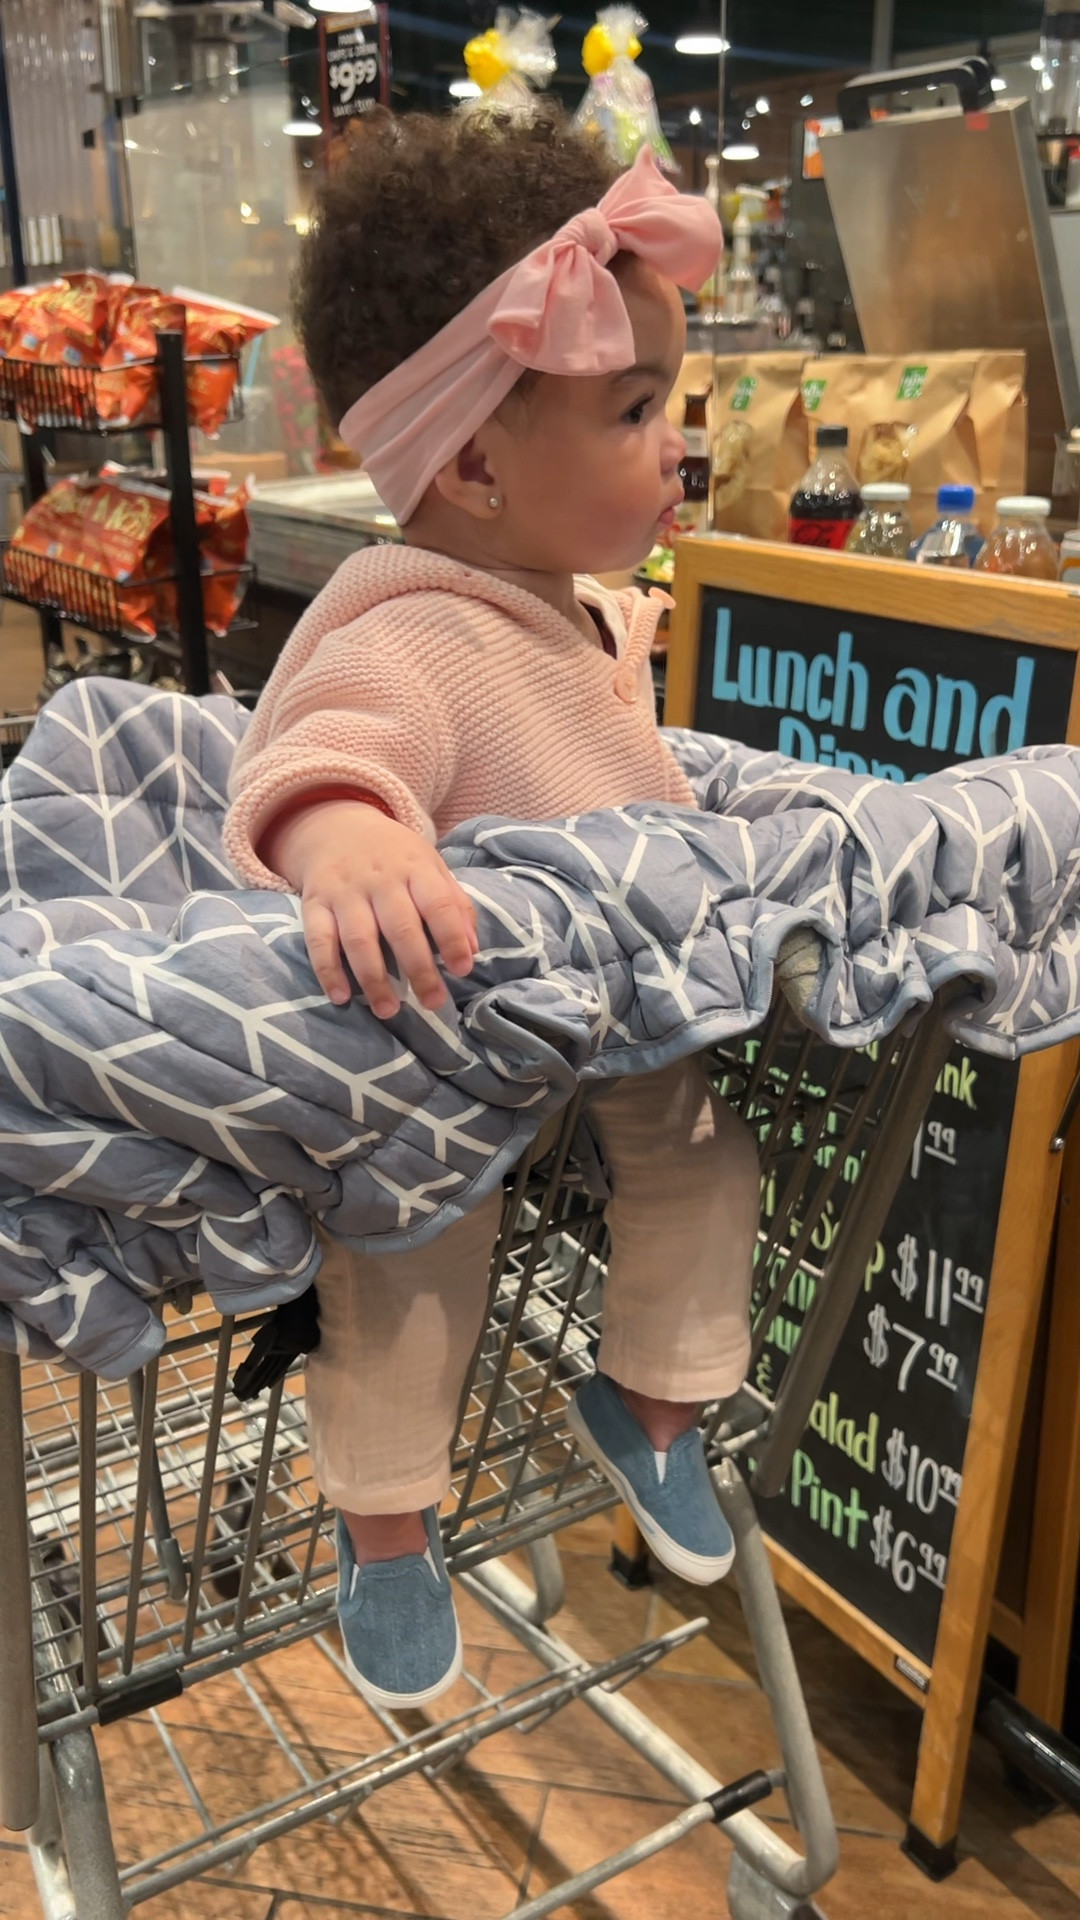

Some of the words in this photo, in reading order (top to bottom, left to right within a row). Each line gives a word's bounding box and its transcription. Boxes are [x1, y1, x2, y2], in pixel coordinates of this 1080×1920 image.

[712, 607, 869, 731] Lunch
[883, 657, 1035, 759] and
[808, 1391, 880, 1474] alad
[791, 1448, 870, 1550] Pint
